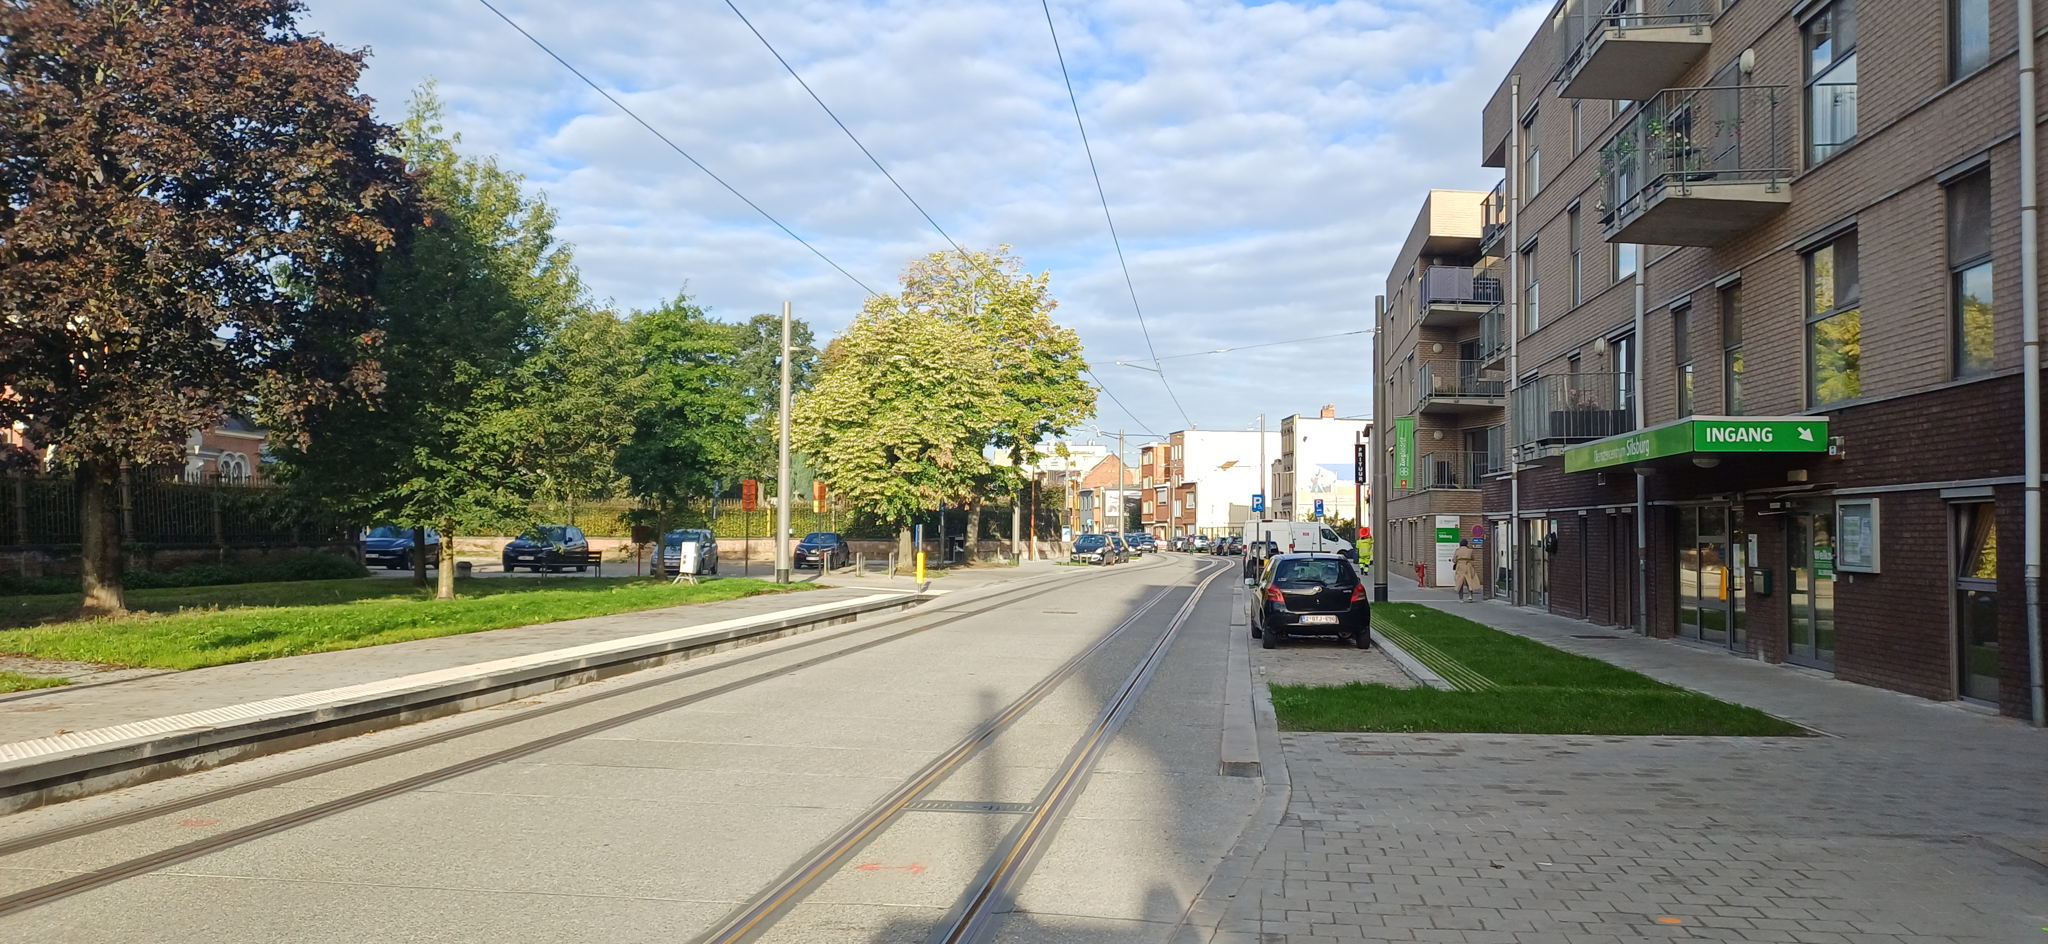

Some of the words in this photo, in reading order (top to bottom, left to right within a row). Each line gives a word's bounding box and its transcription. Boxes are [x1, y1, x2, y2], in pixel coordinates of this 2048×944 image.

[1706, 427, 1773, 442] INGANG
[1626, 437, 1650, 457] Silsburg
[1253, 496, 1262, 509] P
[1316, 499, 1322, 508] P
